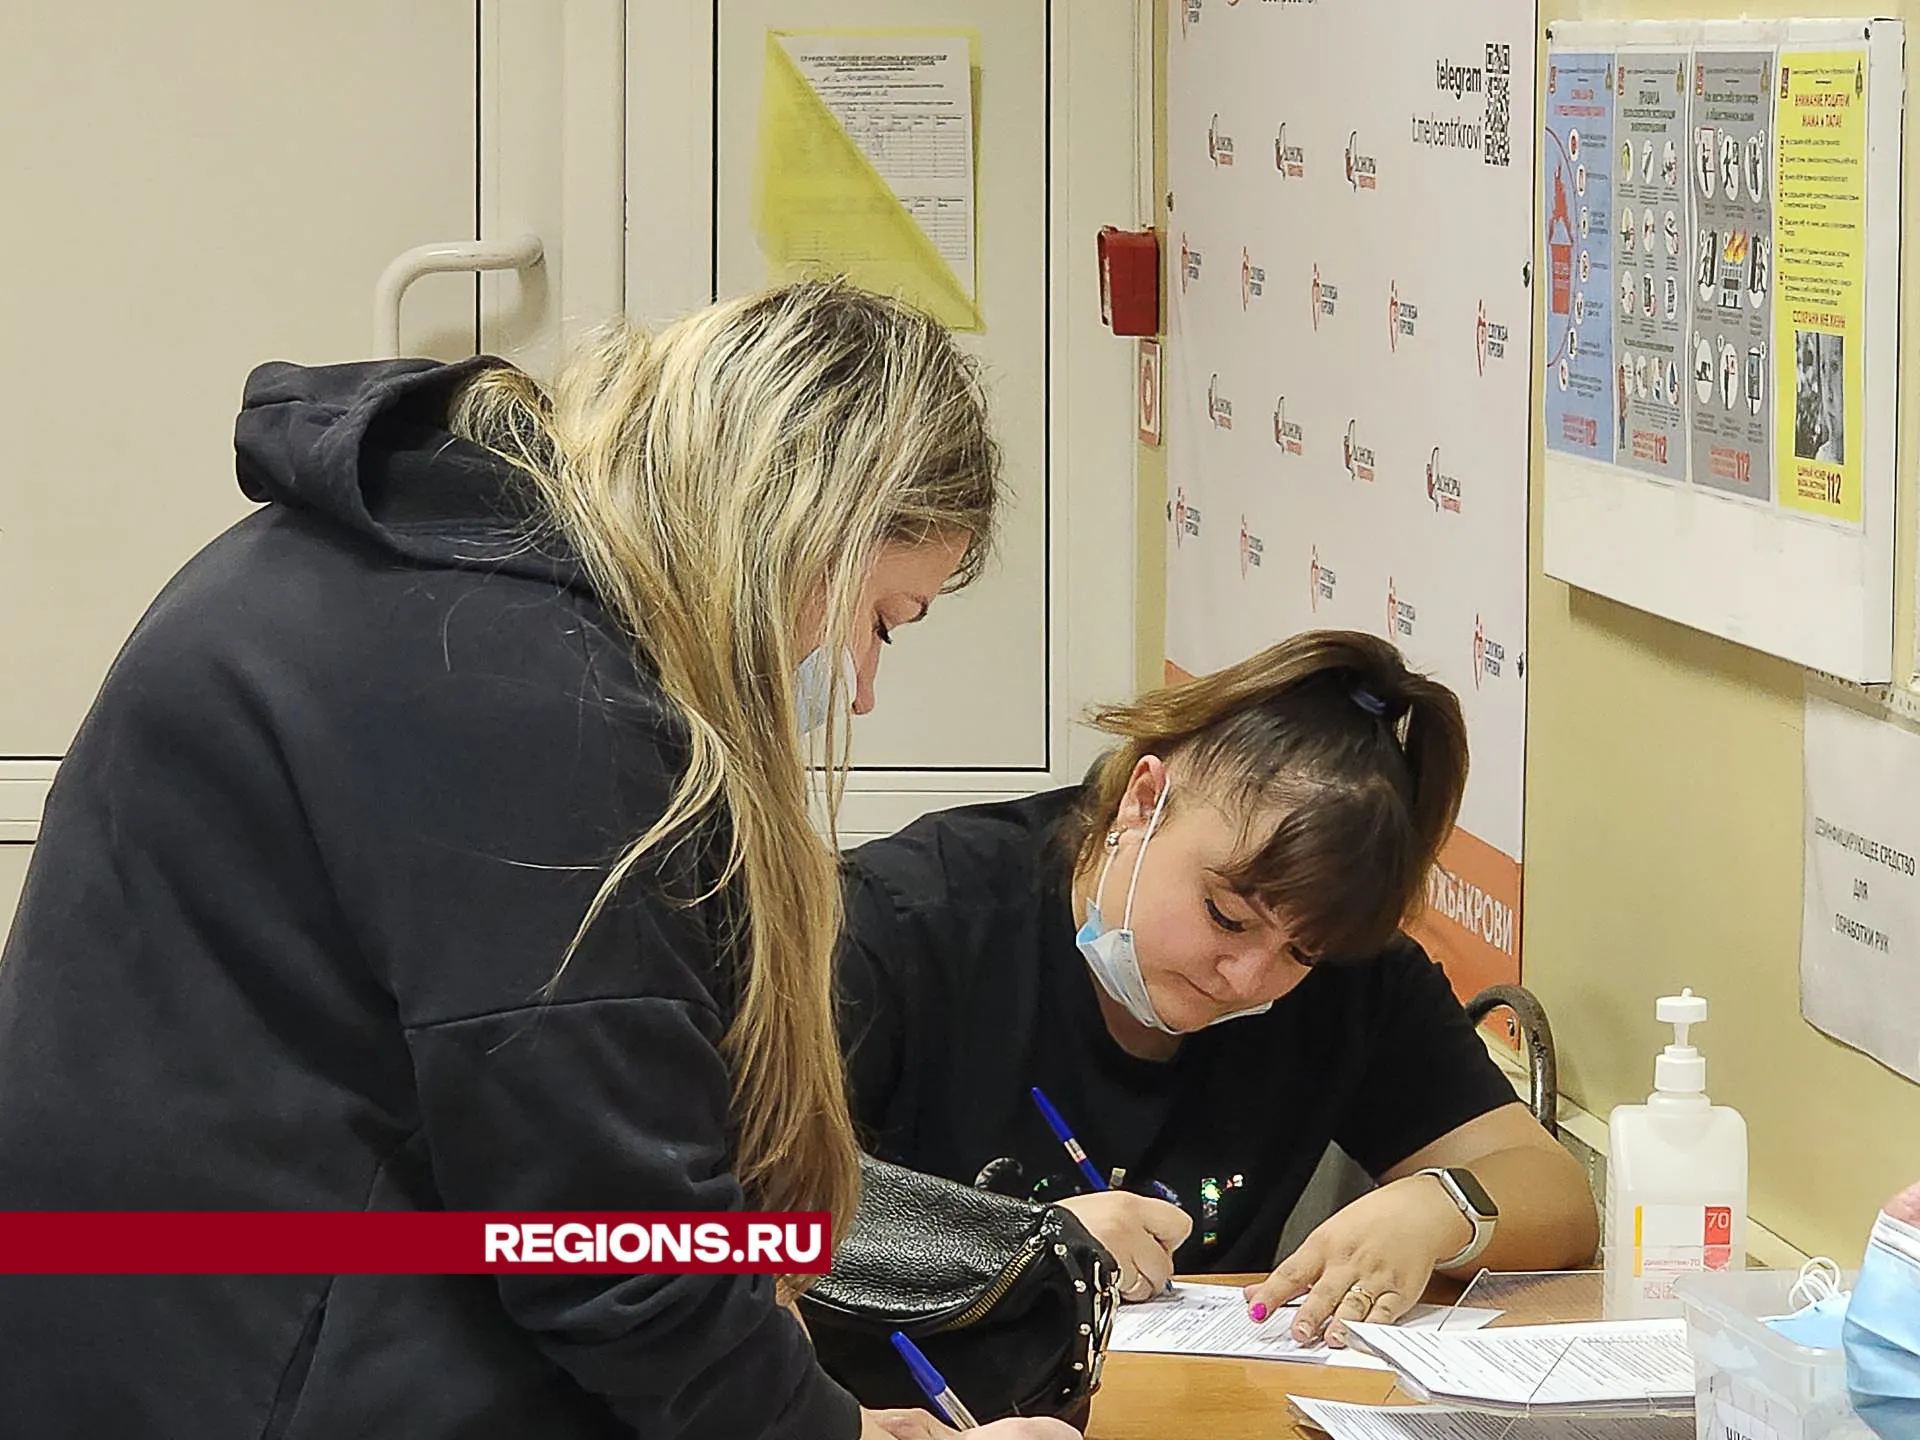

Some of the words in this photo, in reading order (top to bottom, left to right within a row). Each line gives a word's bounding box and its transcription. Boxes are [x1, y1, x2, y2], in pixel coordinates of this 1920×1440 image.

[1436, 58, 1481, 99] telegram
[1412, 112, 1481, 149] t.me/centrkrovi
[1827, 473, 1841, 504] 112
[1880, 845, 1915, 876] СРЕДСТВО
[1853, 878, 1868, 900] ДЛЯ
[1835, 912, 1874, 946] ОБРАБОТКИ
[1874, 930, 1889, 953] РУК
[1707, 1213, 1729, 1229] 70
